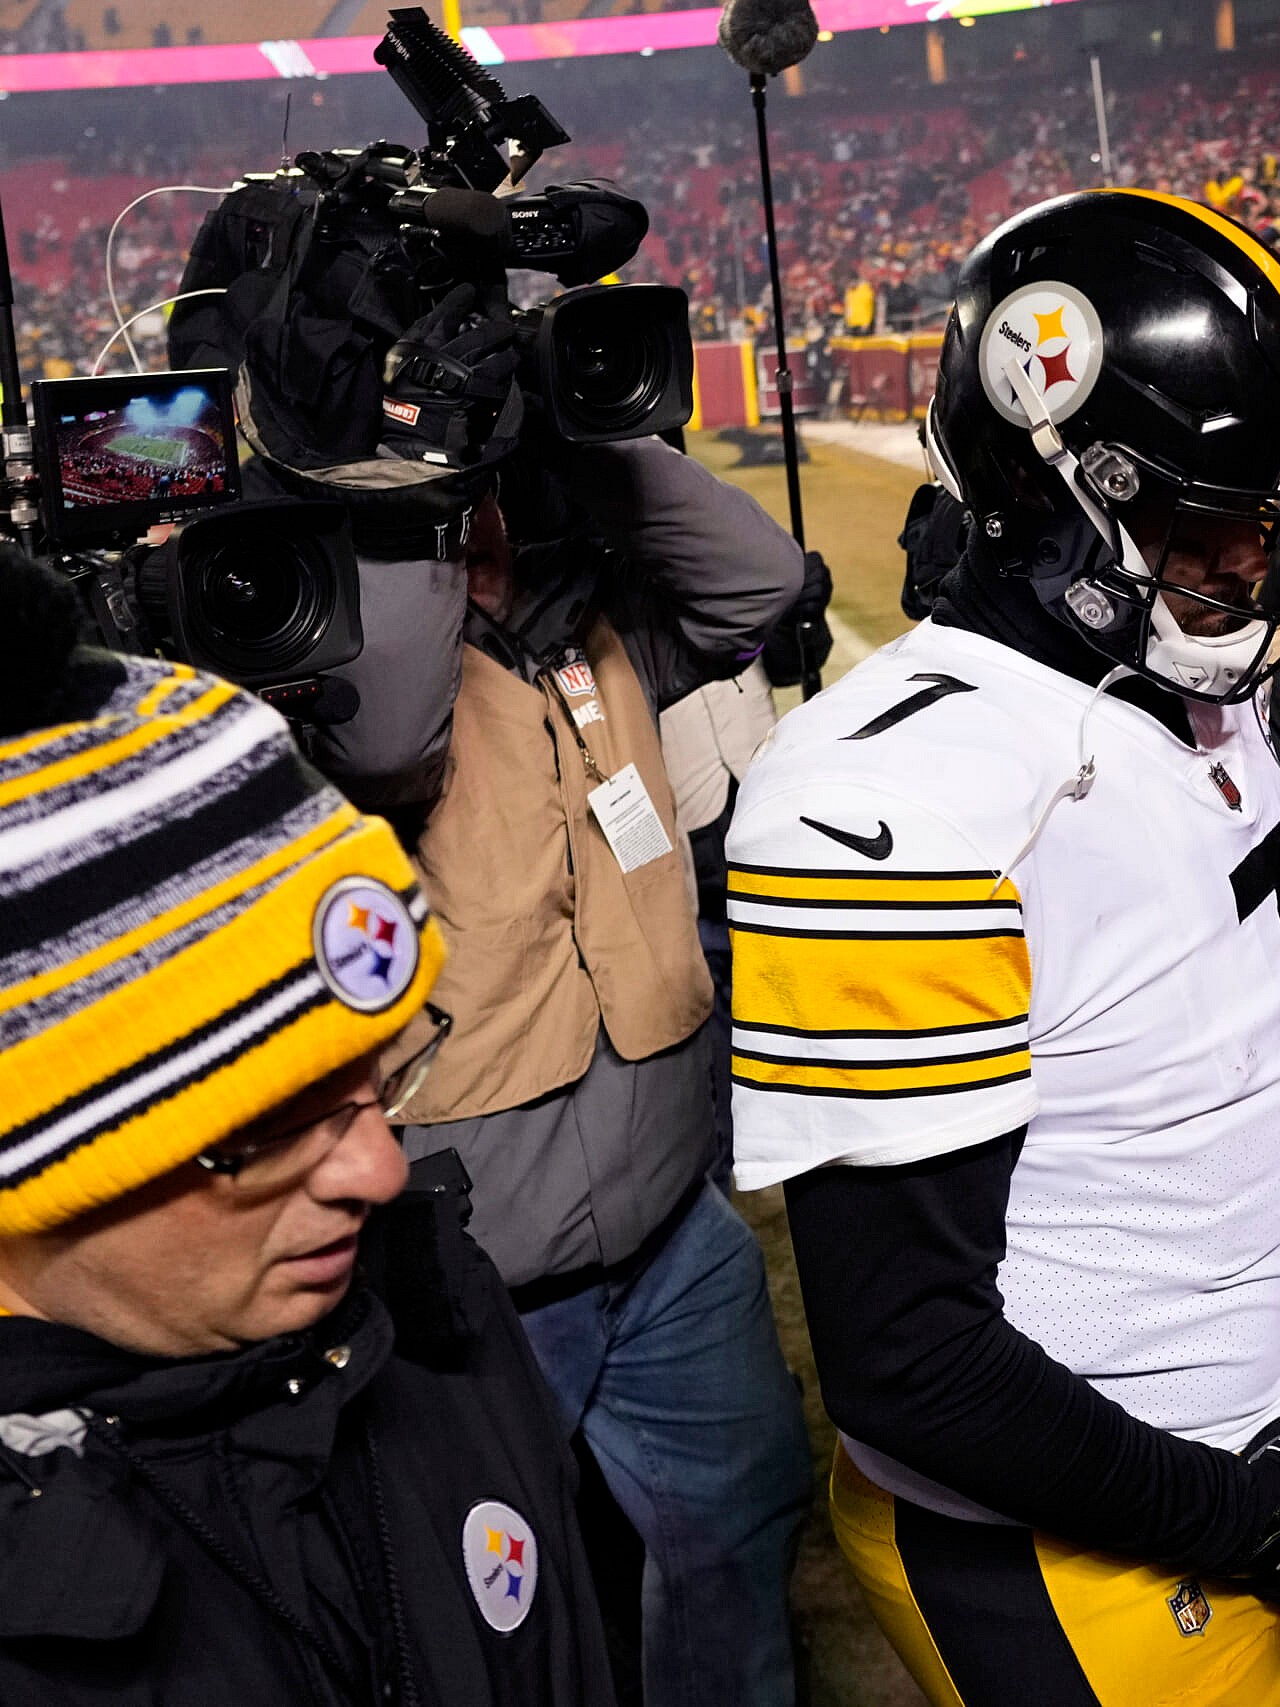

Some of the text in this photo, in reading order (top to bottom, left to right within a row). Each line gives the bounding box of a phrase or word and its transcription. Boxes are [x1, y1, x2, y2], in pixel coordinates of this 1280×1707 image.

[511, 209, 539, 219] SONY
[998, 320, 1032, 353] Steelers
[837, 676, 980, 740] 7
